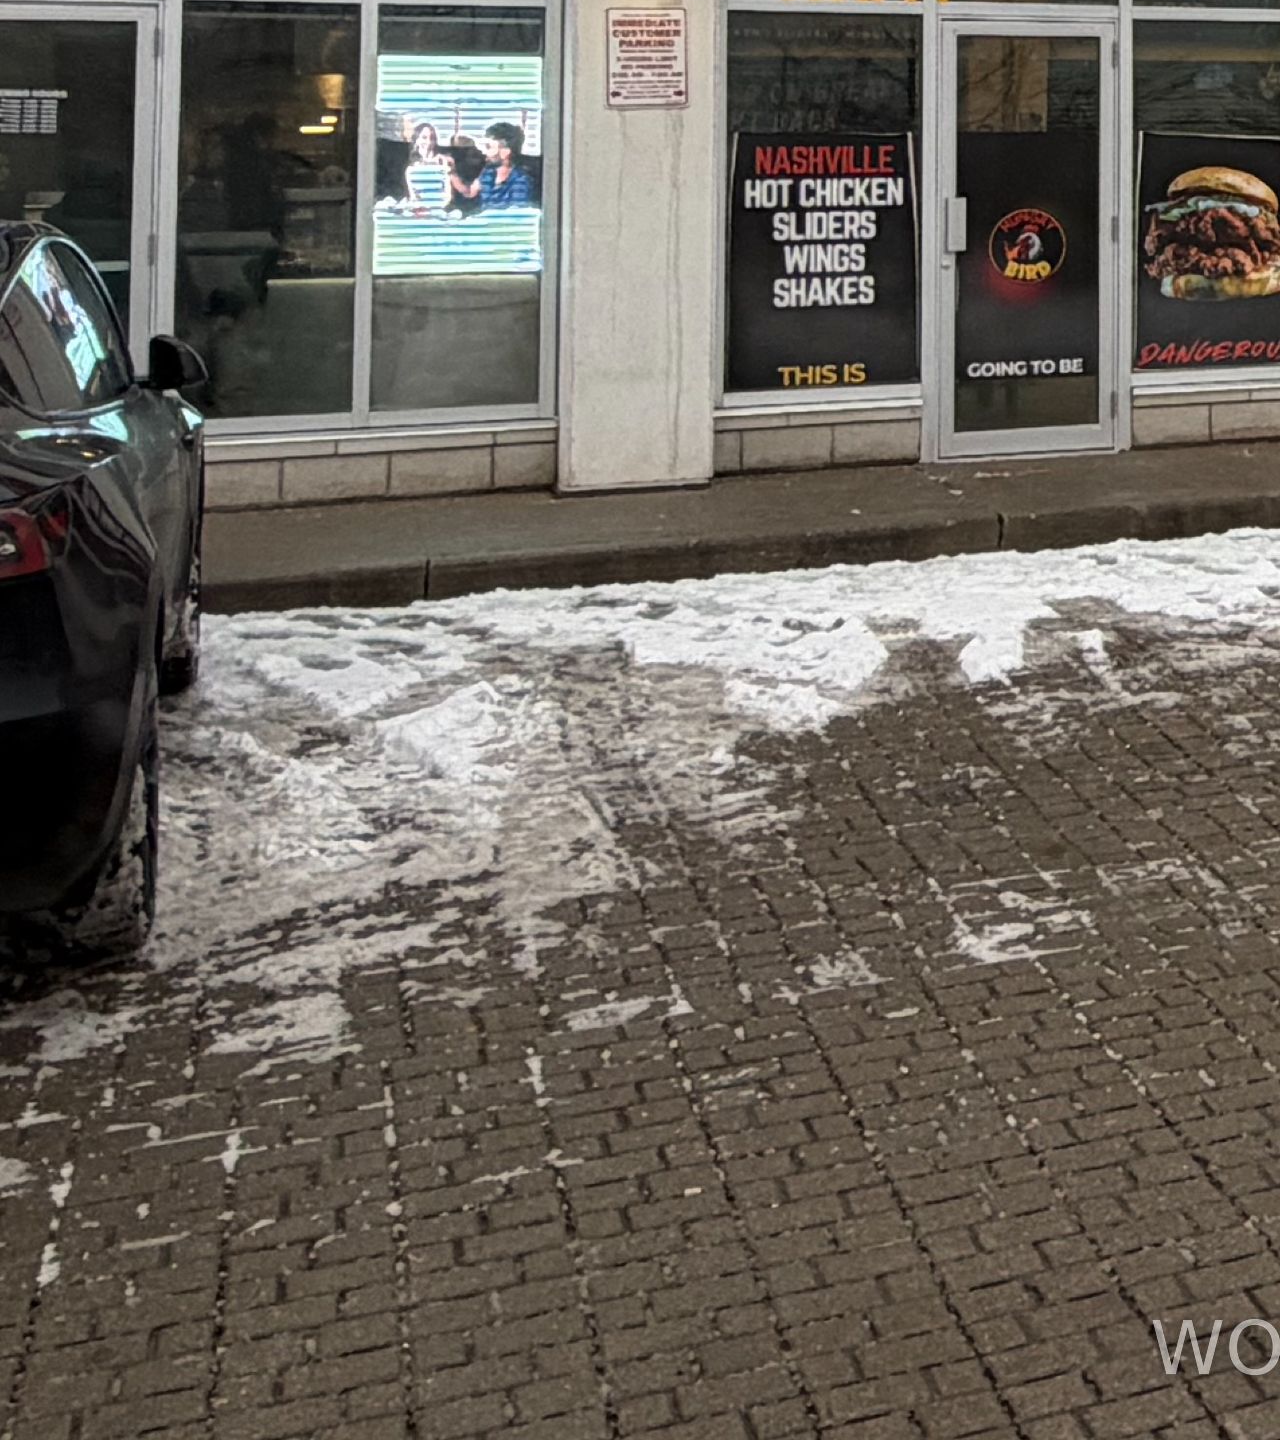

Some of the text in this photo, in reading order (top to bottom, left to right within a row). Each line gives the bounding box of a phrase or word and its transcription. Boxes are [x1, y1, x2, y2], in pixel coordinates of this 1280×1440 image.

[755, 145, 896, 175] NASHVILLE
[744, 177, 904, 209] HOT CHICKEN
[772, 211, 877, 241] SLIDERS
[784, 243, 866, 275] WINGS
[1003, 260, 1051, 280] BIRD
[773, 276, 875, 308] SHAKES
[777, 363, 865, 386] THIS IS
[967, 358, 1083, 378] GOING TO BE
